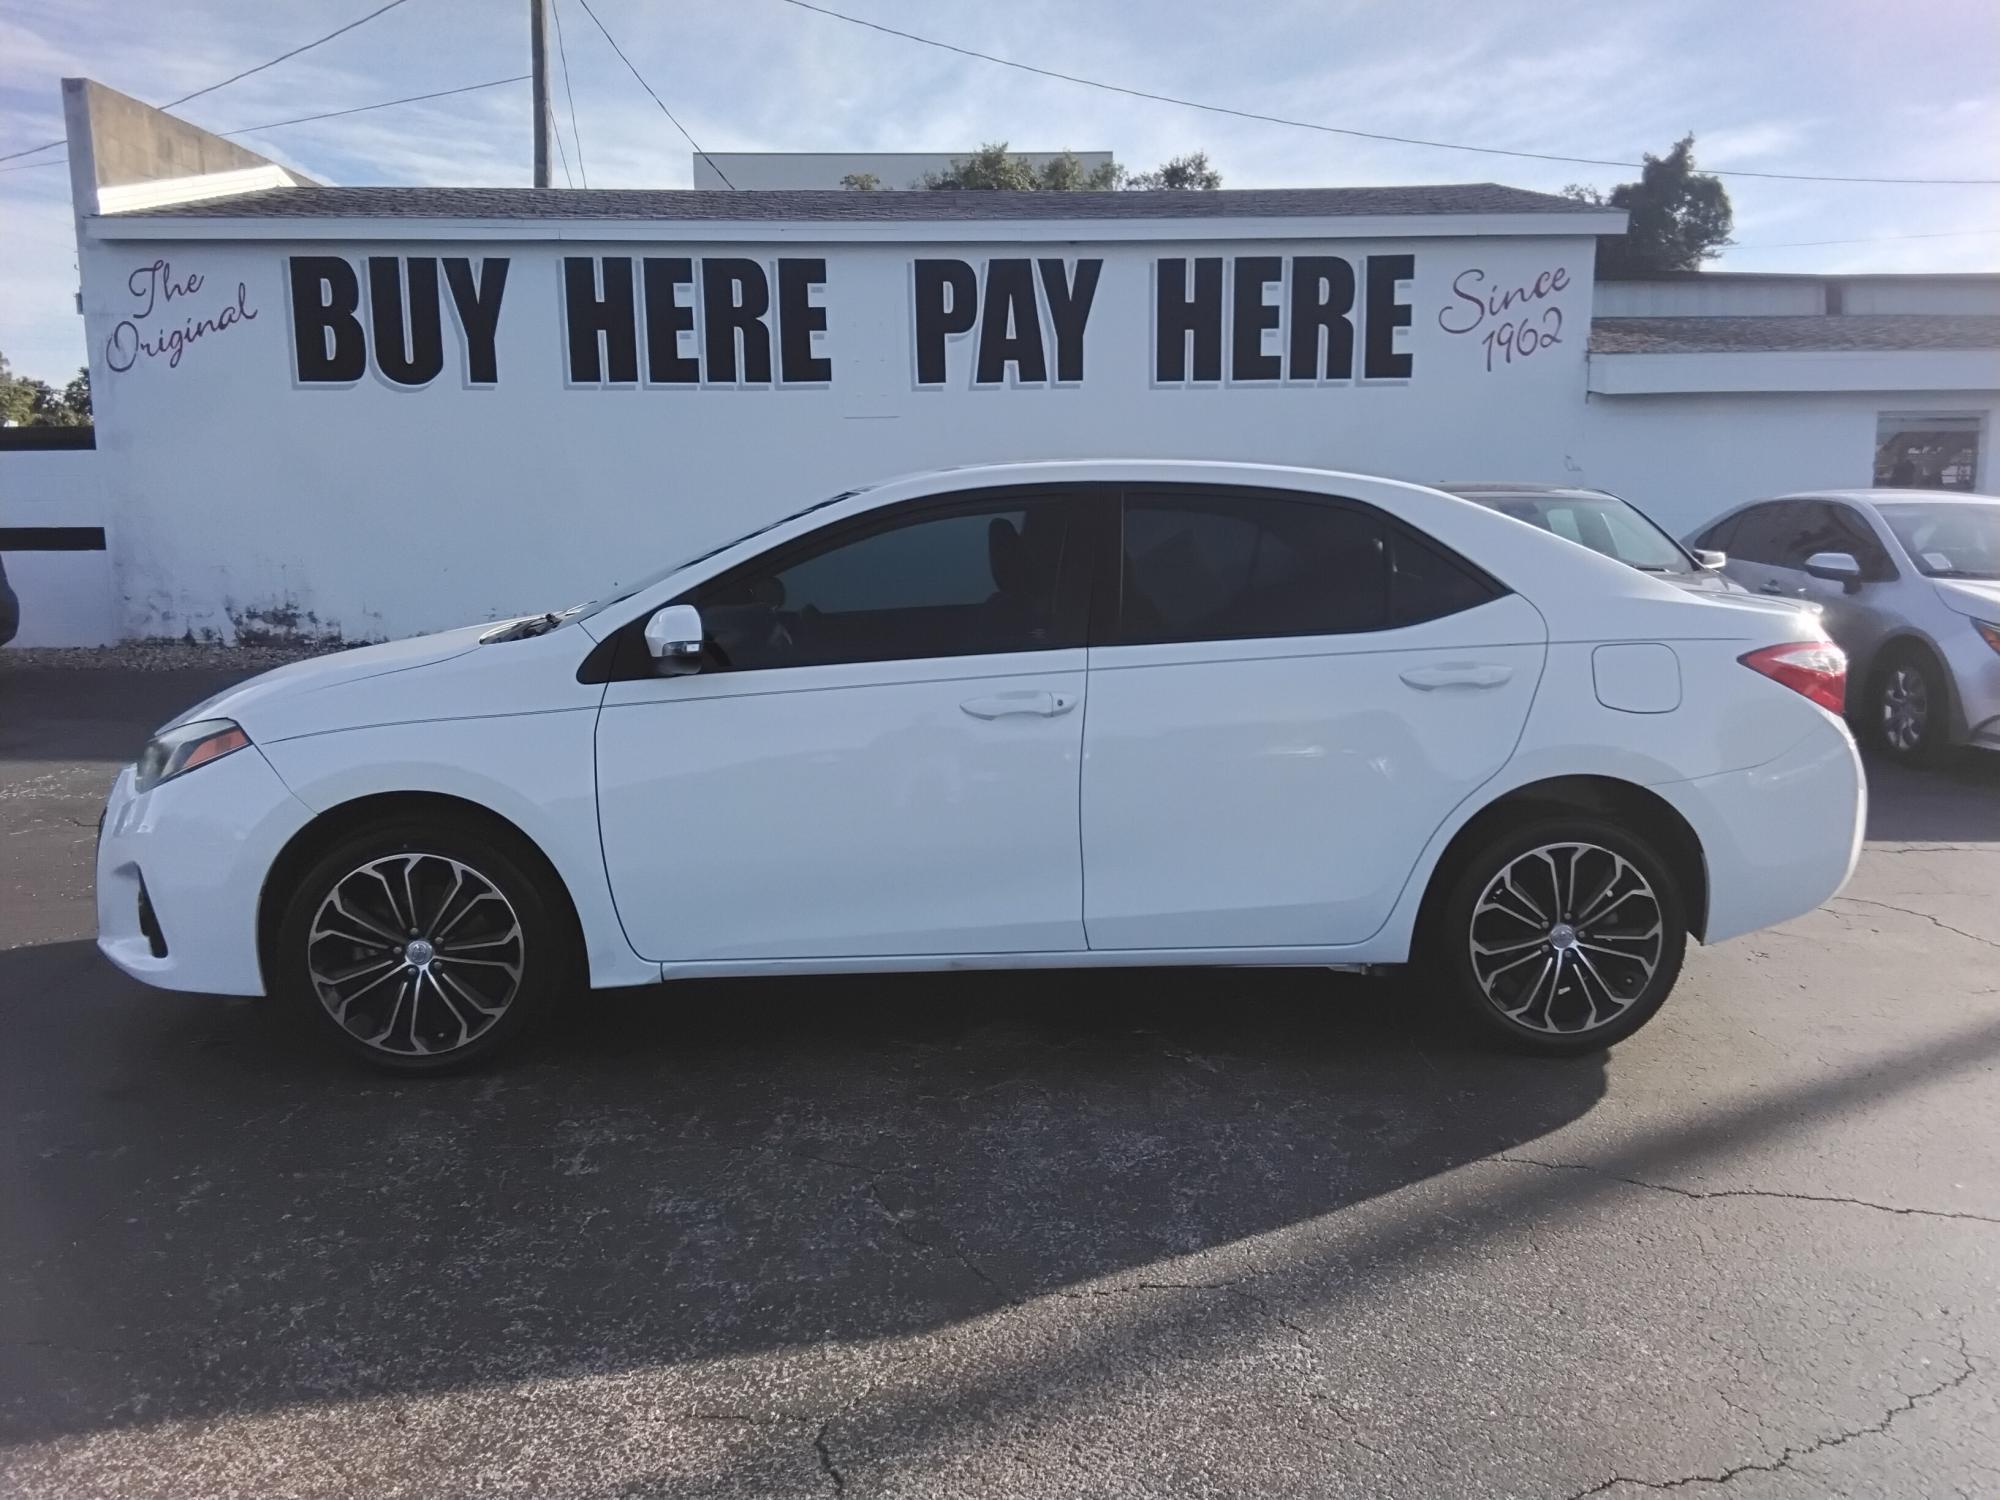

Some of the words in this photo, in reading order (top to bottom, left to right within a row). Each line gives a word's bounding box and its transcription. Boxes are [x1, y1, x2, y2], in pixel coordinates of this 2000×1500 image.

[129, 260, 204, 319] The
[289, 256, 510, 385] BUY
[563, 257, 832, 384] HERE
[914, 258, 1104, 385] PAY
[1156, 254, 1415, 382] HERE
[1438, 265, 1571, 334] Since
[107, 283, 258, 373] Original
[1481, 306, 1564, 372] 1962
